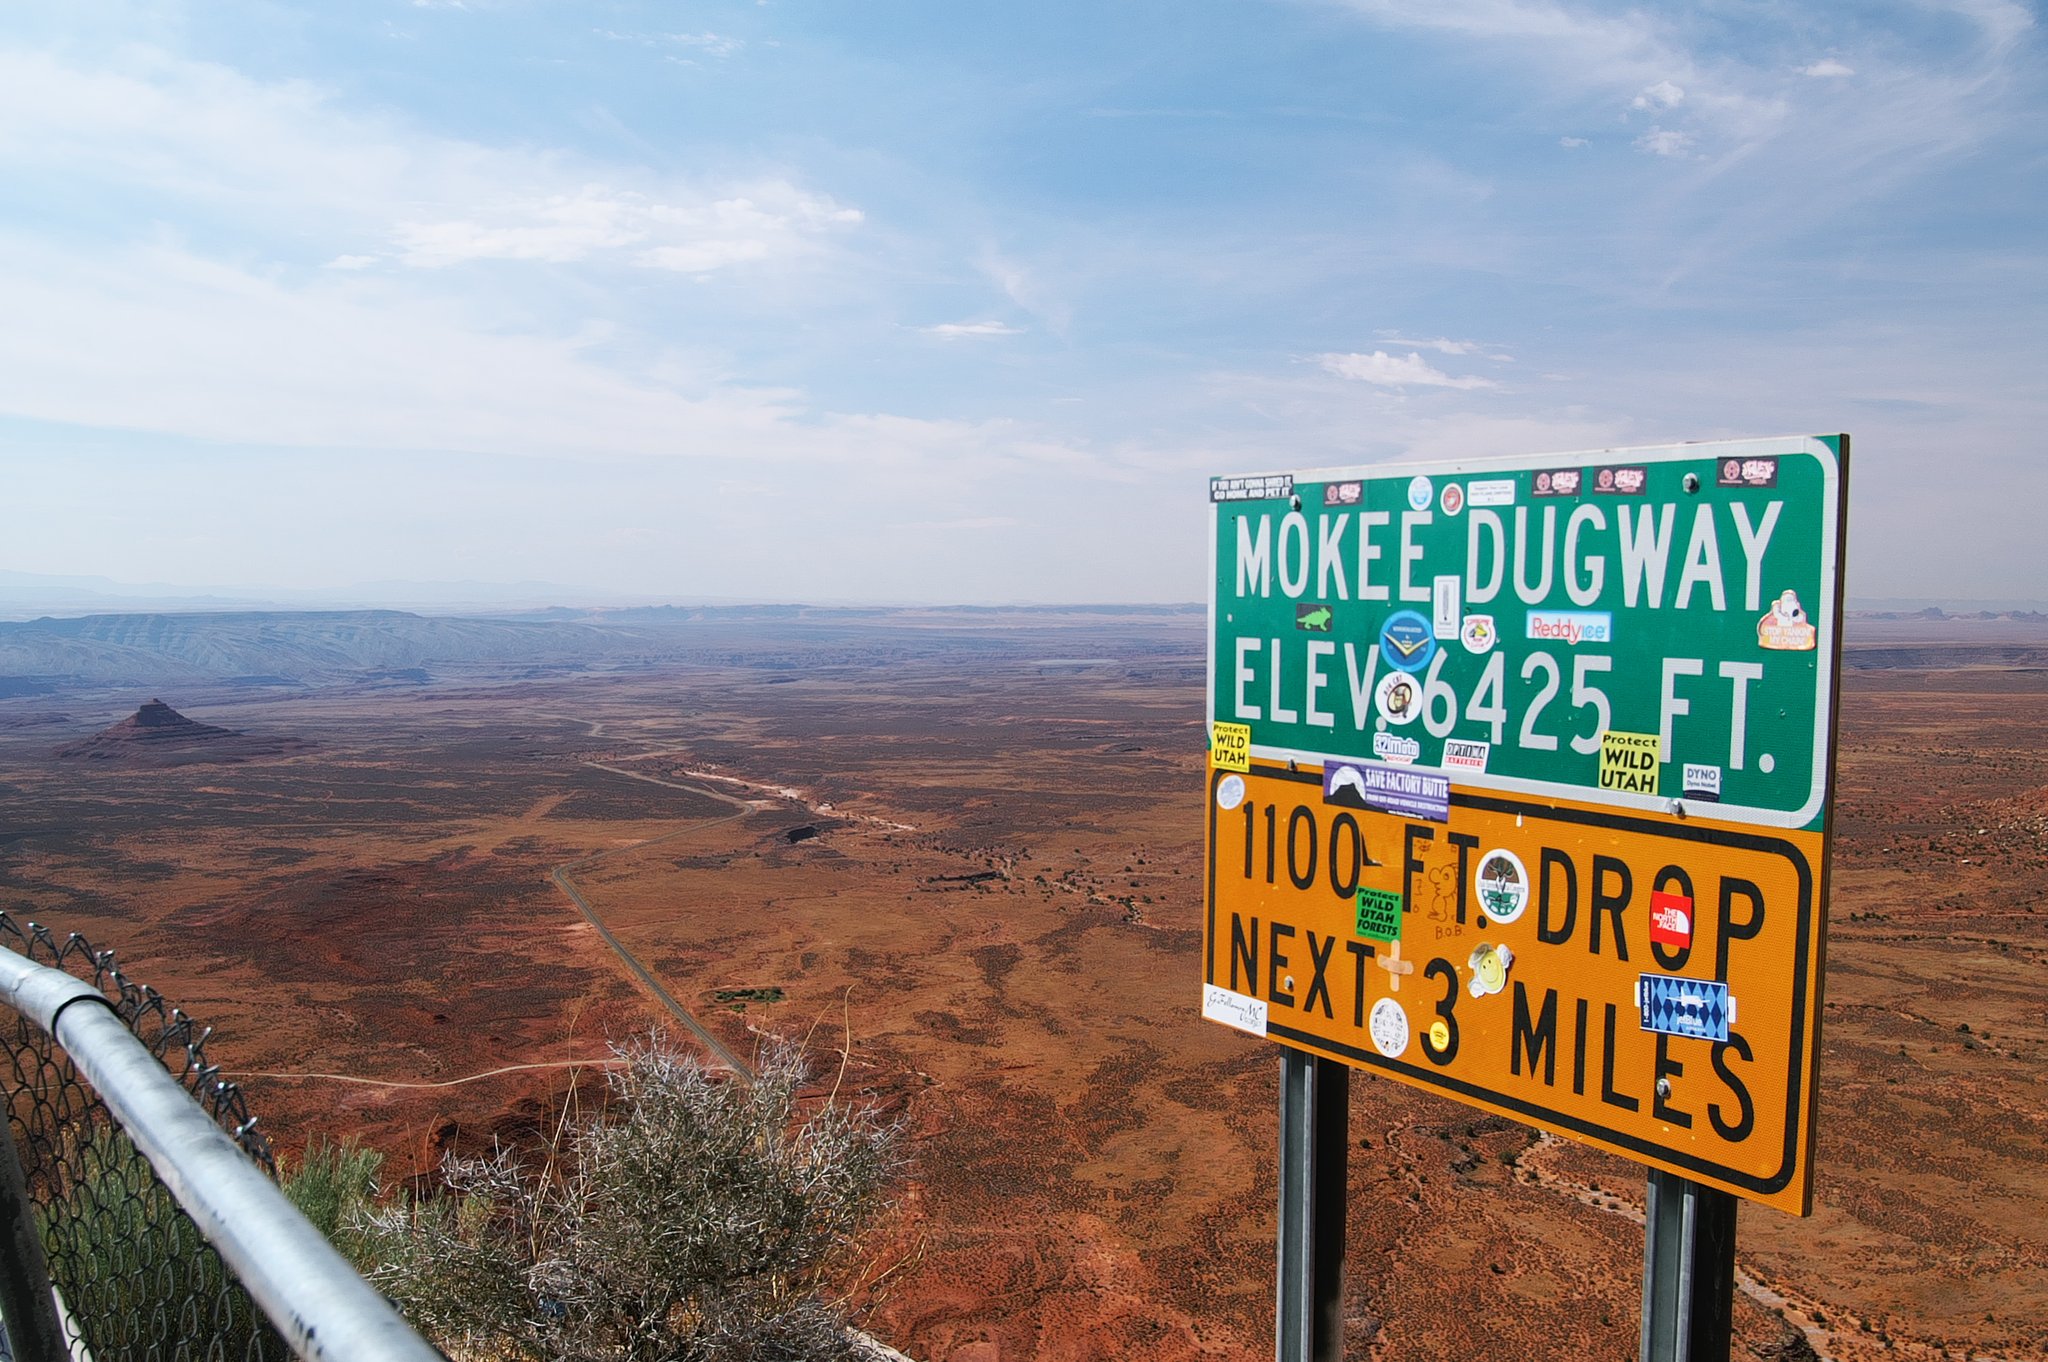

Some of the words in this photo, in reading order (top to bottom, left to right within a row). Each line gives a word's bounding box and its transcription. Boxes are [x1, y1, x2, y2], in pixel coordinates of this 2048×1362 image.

[1236, 510, 1433, 602] MOKEE
[1466, 501, 1783, 611] DUGWAY
[1235, 637, 1387, 732] ELEV.
[1421, 647, 1612, 755] 6425
[1659, 658, 1775, 773] FT.
[1214, 724, 1248, 735] Protect
[1216, 733, 1245, 749] WILD
[1603, 734, 1657, 748] Protect
[1215, 749, 1246, 765] UTAH
[1447, 742, 1486, 759] OPTIMA
[1605, 747, 1655, 771] WILD
[1601, 769, 1655, 793] UTAH
[1687, 768, 1717, 780] DYNO
[1365, 768, 1386, 789] SAVE
[1386, 771, 1421, 794] FACTORY
[1422, 776, 1448, 798] BUTTE
[1243, 800, 1361, 900] 1100
[1402, 824, 1487, 930] FT.
[1537, 847, 1765, 982] DROP
[1357, 887, 1400, 902] Protect
[1361, 896, 1394, 912] WILD
[1664, 907, 1677, 917] THE
[1360, 908, 1395, 924] UTAH
[1653, 912, 1677, 925] NORTH
[1357, 919, 1398, 937] FORESTS
[1230, 912, 1375, 1028] NEXT
[1419, 957, 1460, 1066] 3
[1511, 981, 1754, 1142] MILES
